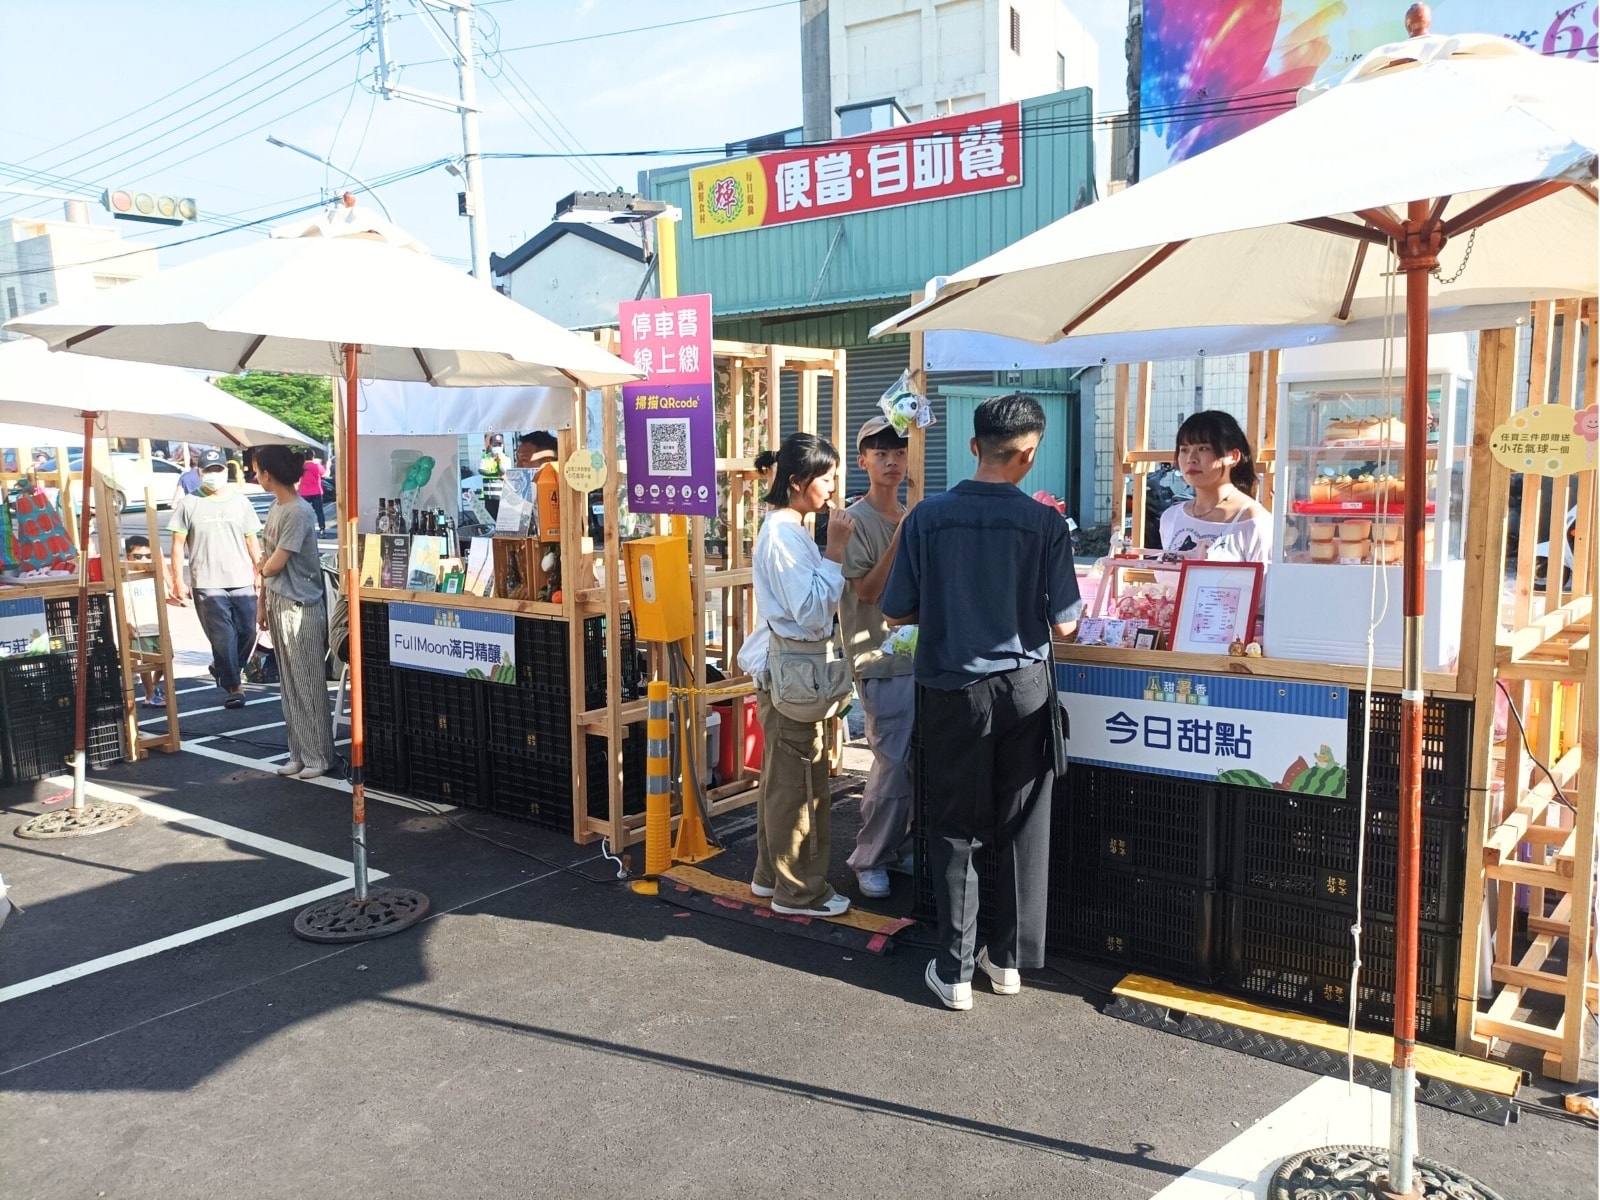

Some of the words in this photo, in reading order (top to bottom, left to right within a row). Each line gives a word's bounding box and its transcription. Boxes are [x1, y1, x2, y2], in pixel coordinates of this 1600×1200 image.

[632, 309, 698, 342] 停車費
[633, 345, 700, 374] 線上繳
[1499, 443, 1570, 454] 小花氣球一個
[1500, 433, 1571, 442] 任買三件即贈送
[394, 633, 502, 665] FullMoon滿月精釀
[1105, 711, 1253, 760] 今日甜點
